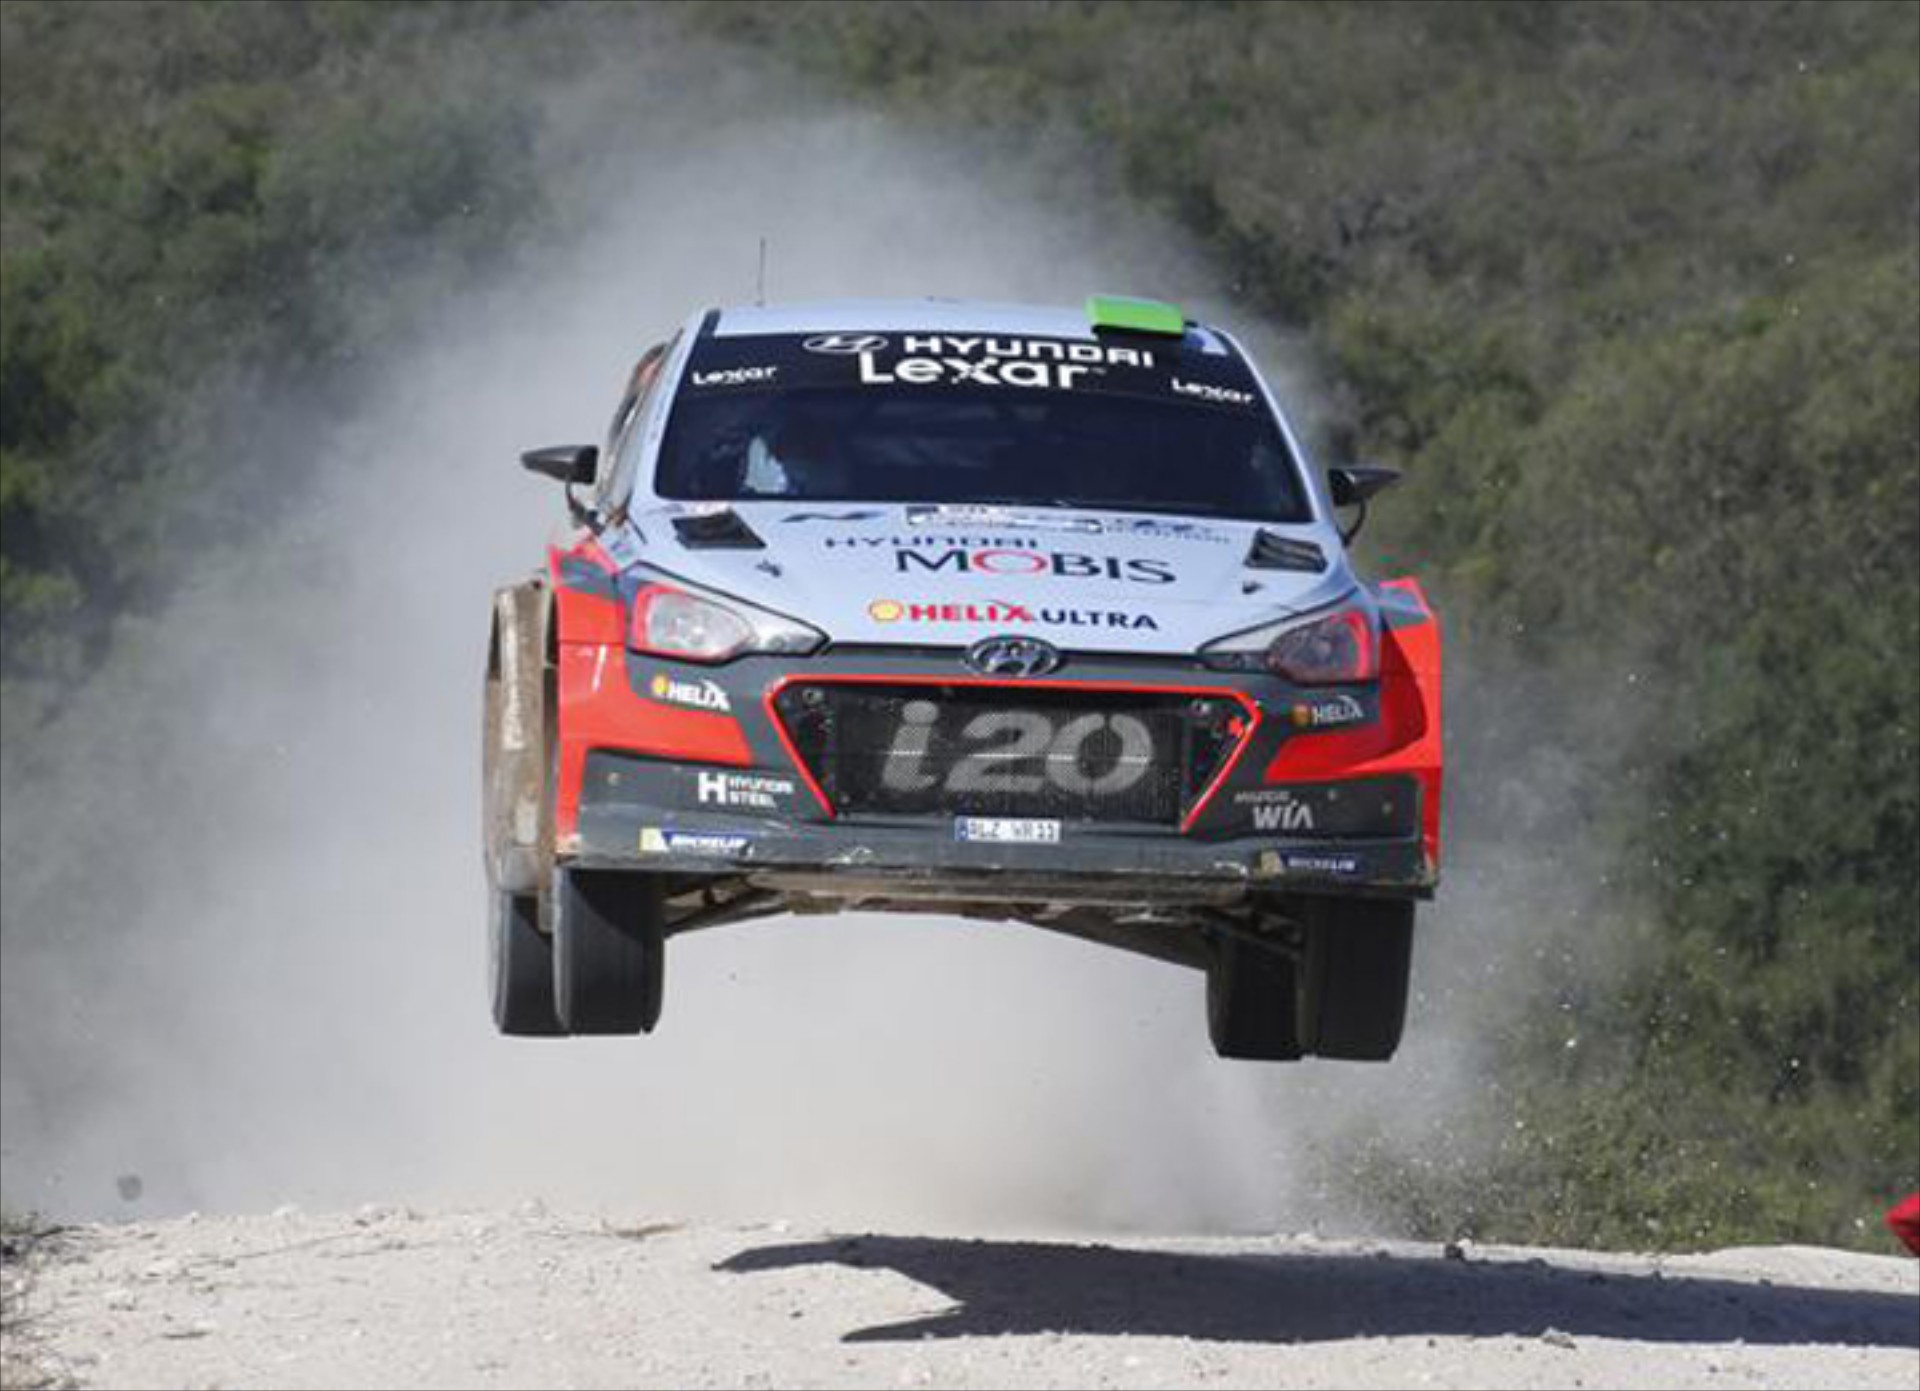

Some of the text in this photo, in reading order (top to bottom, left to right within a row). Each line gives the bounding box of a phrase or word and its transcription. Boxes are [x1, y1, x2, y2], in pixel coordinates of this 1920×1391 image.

[904, 336, 1154, 368] HYUNDAI
[692, 365, 778, 385] Lexar
[859, 349, 1089, 390] Lexar
[1171, 376, 1256, 403] Lexar
[825, 535, 1038, 549] HYUNDAI
[896, 549, 1177, 585] MOBIS
[908, 601, 1160, 631] HELIX ULTRA
[667, 679, 732, 712] HELIX
[1311, 695, 1365, 725] HELIX
[881, 699, 1154, 796] i20
